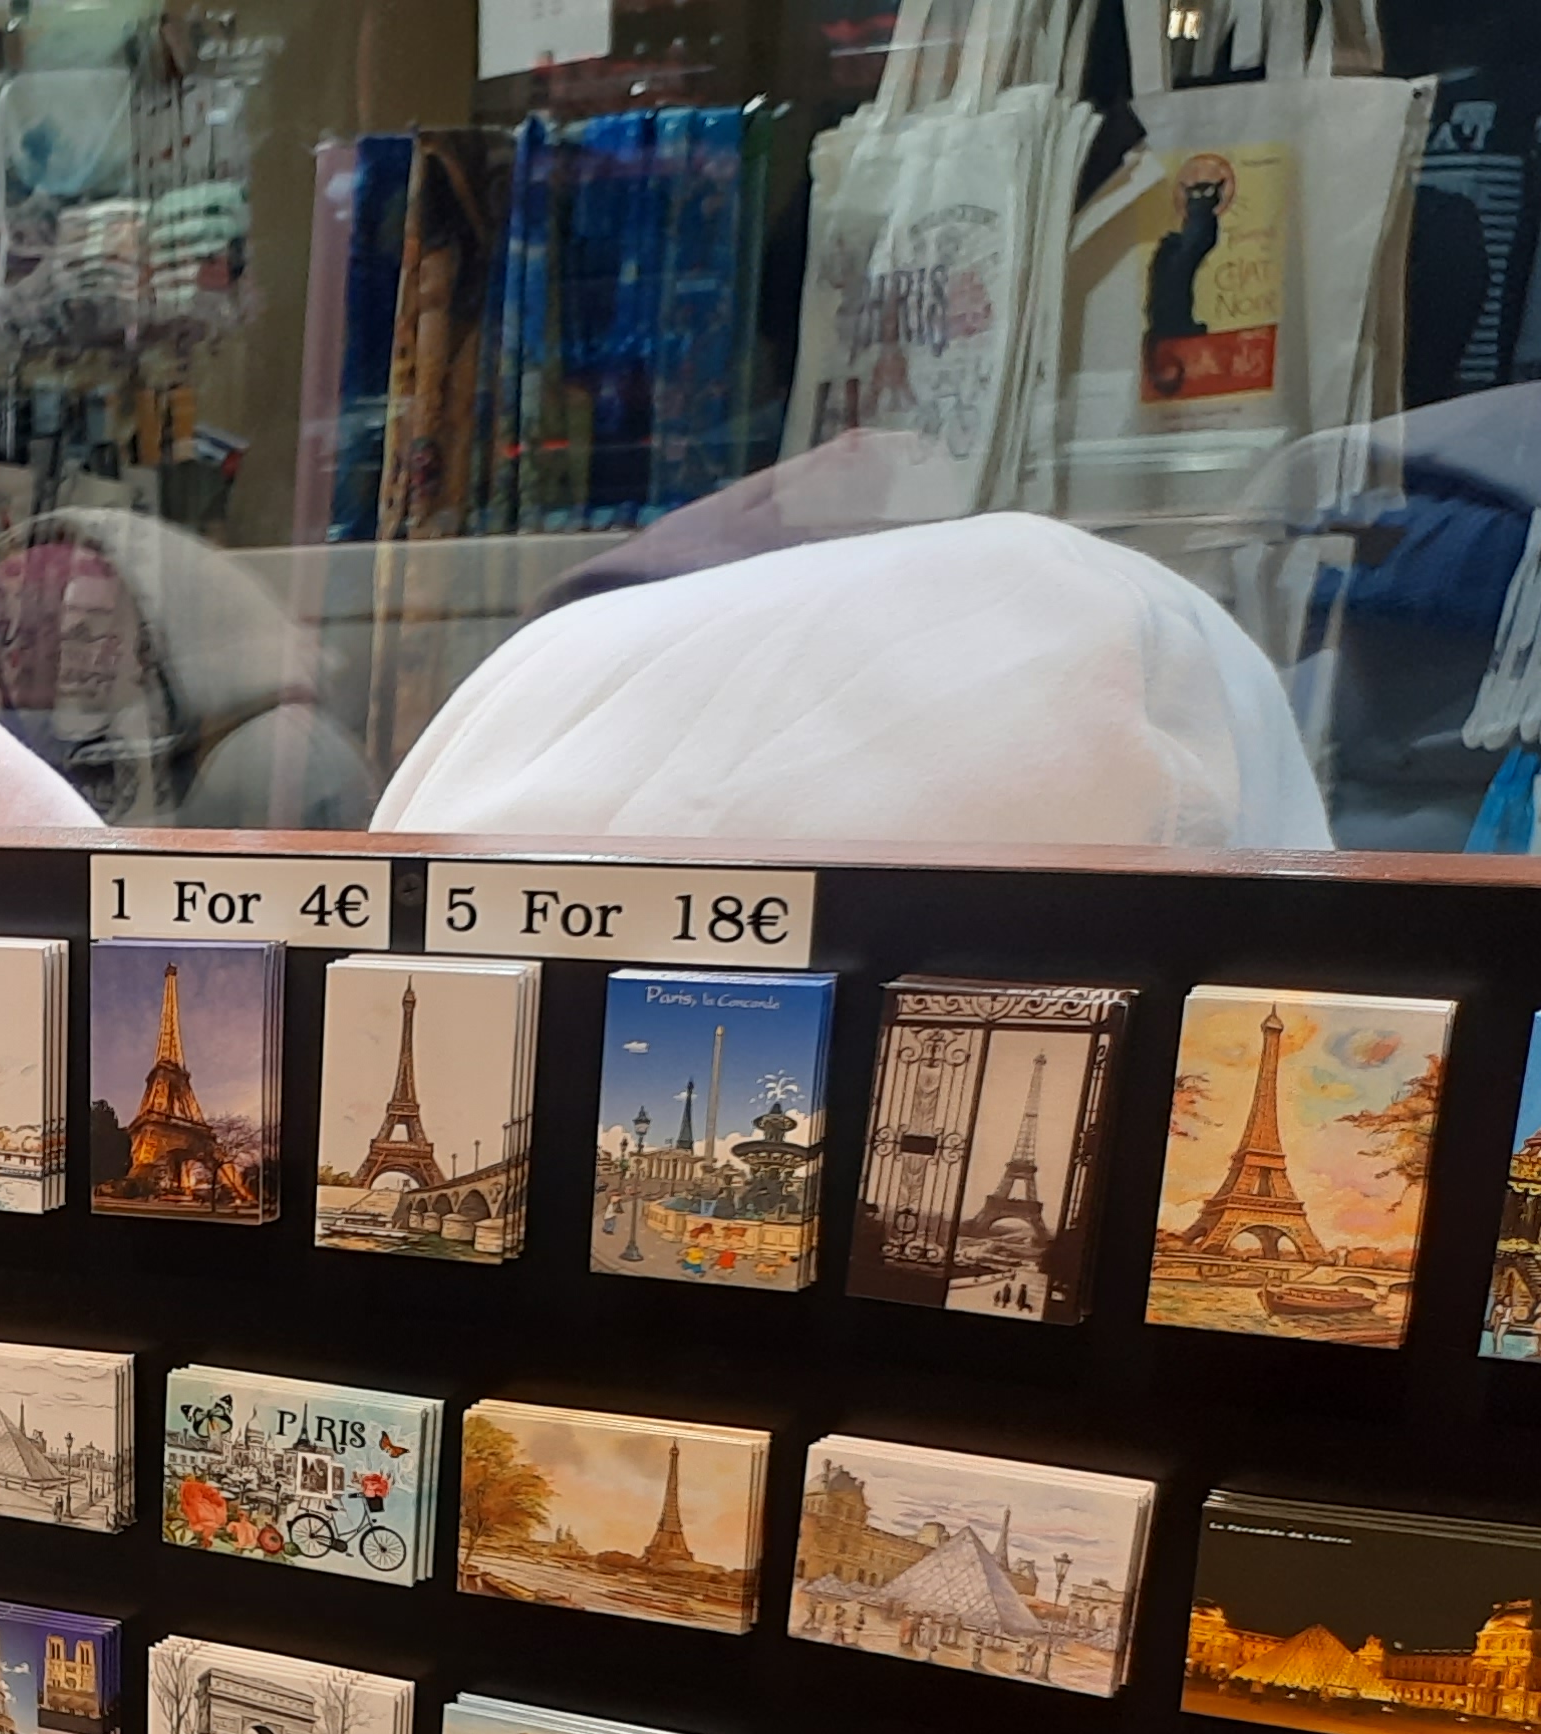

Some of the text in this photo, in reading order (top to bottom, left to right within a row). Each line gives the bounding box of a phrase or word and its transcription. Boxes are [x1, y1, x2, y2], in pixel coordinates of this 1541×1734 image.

[110, 878, 371, 929] 1 For 4€
[445, 887, 790, 945] 5 For 18€
